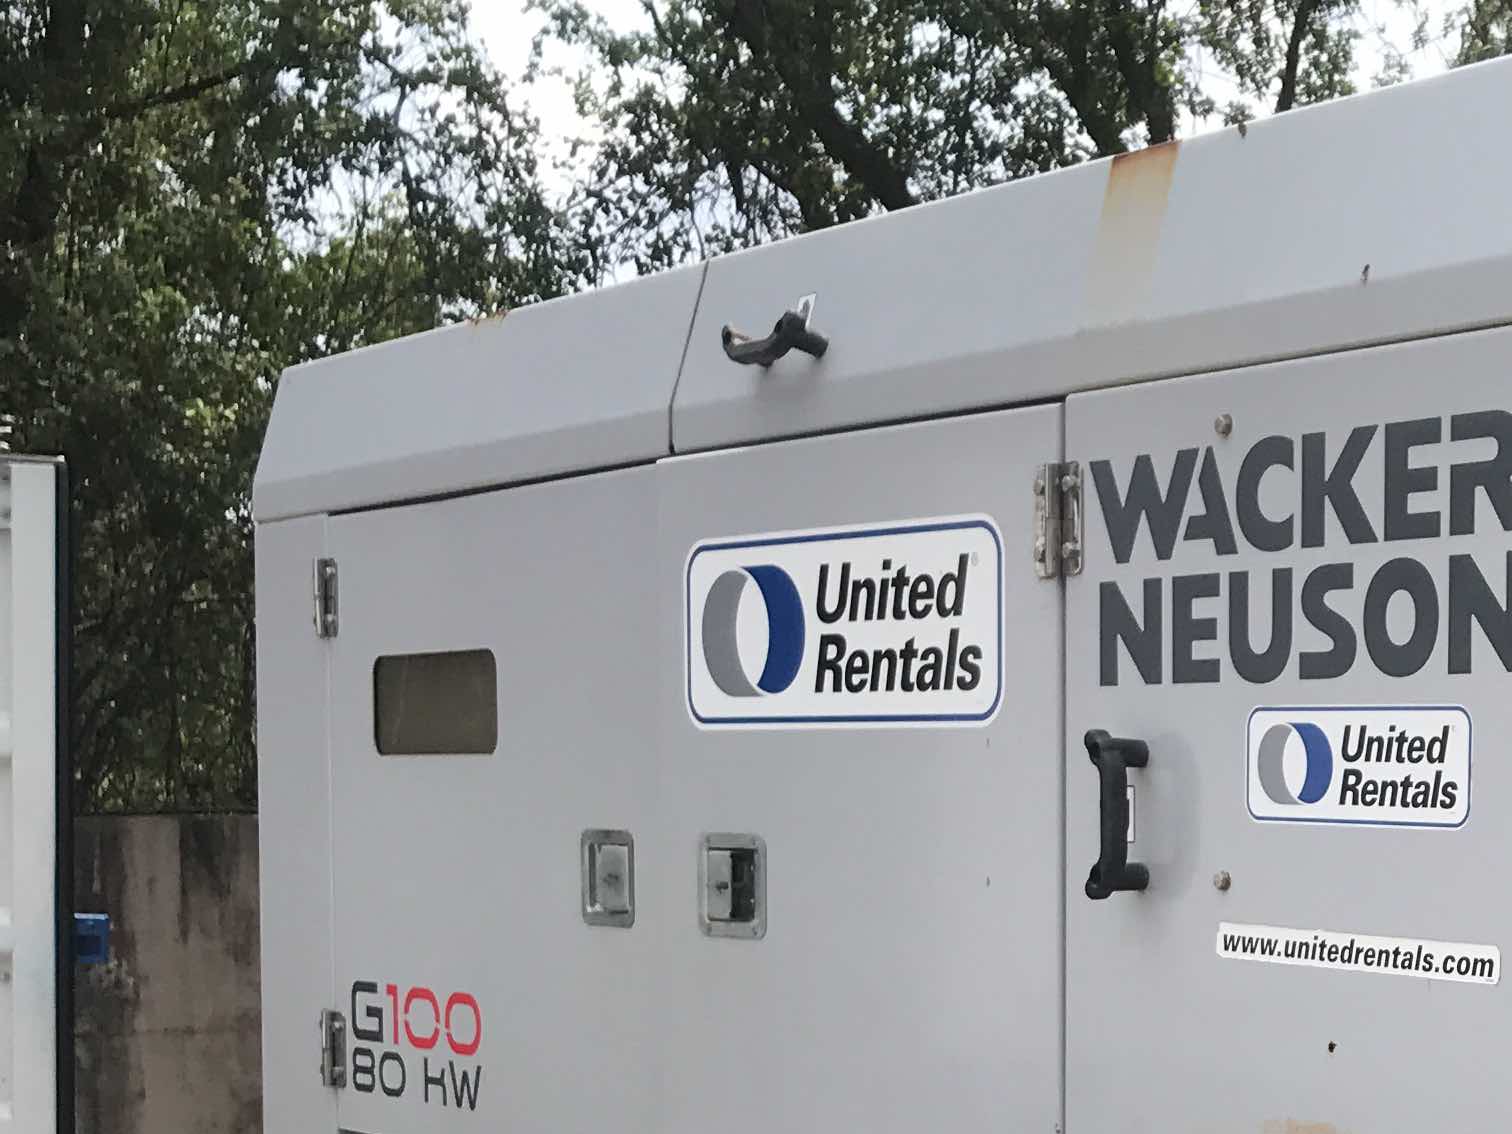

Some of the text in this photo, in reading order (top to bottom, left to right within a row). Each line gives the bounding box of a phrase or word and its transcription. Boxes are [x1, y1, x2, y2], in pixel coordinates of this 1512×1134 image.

[814, 552, 971, 625] United
[814, 630, 983, 695] Rentals
[1340, 723, 1449, 766] United
[1339, 767, 1459, 811] Rentals
[1222, 931, 1496, 979] www.unitedrentals.com
[351, 980, 482, 1057] G100
[352, 1046, 407, 1098] 80
